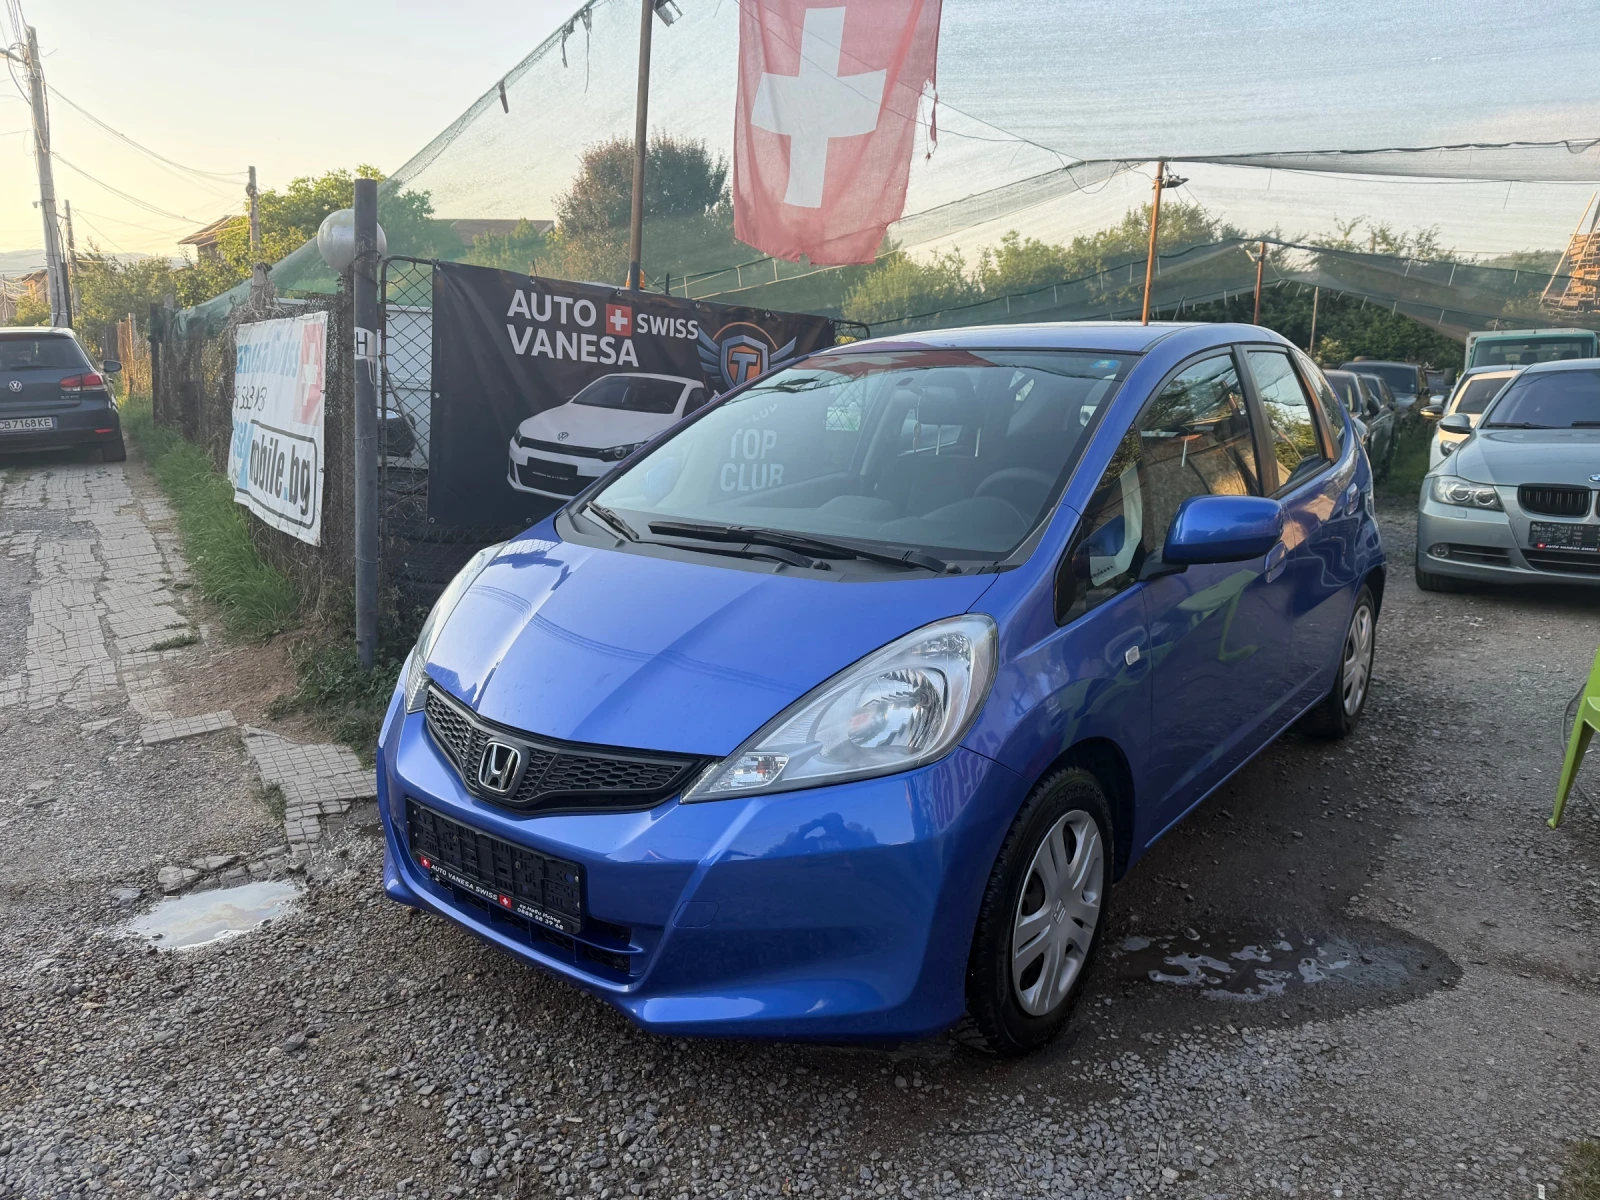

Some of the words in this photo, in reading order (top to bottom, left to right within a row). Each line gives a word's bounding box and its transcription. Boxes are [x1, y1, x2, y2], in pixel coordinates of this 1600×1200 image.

[506, 289, 597, 327] AUTO
[636, 313, 699, 340] SWISS
[506, 323, 640, 367] VANESA
[730, 428, 777, 460] TOP
[431, 864, 447, 876] AUTO
[448, 873, 474, 890] VANESA
[475, 886, 498, 901] SWISS
